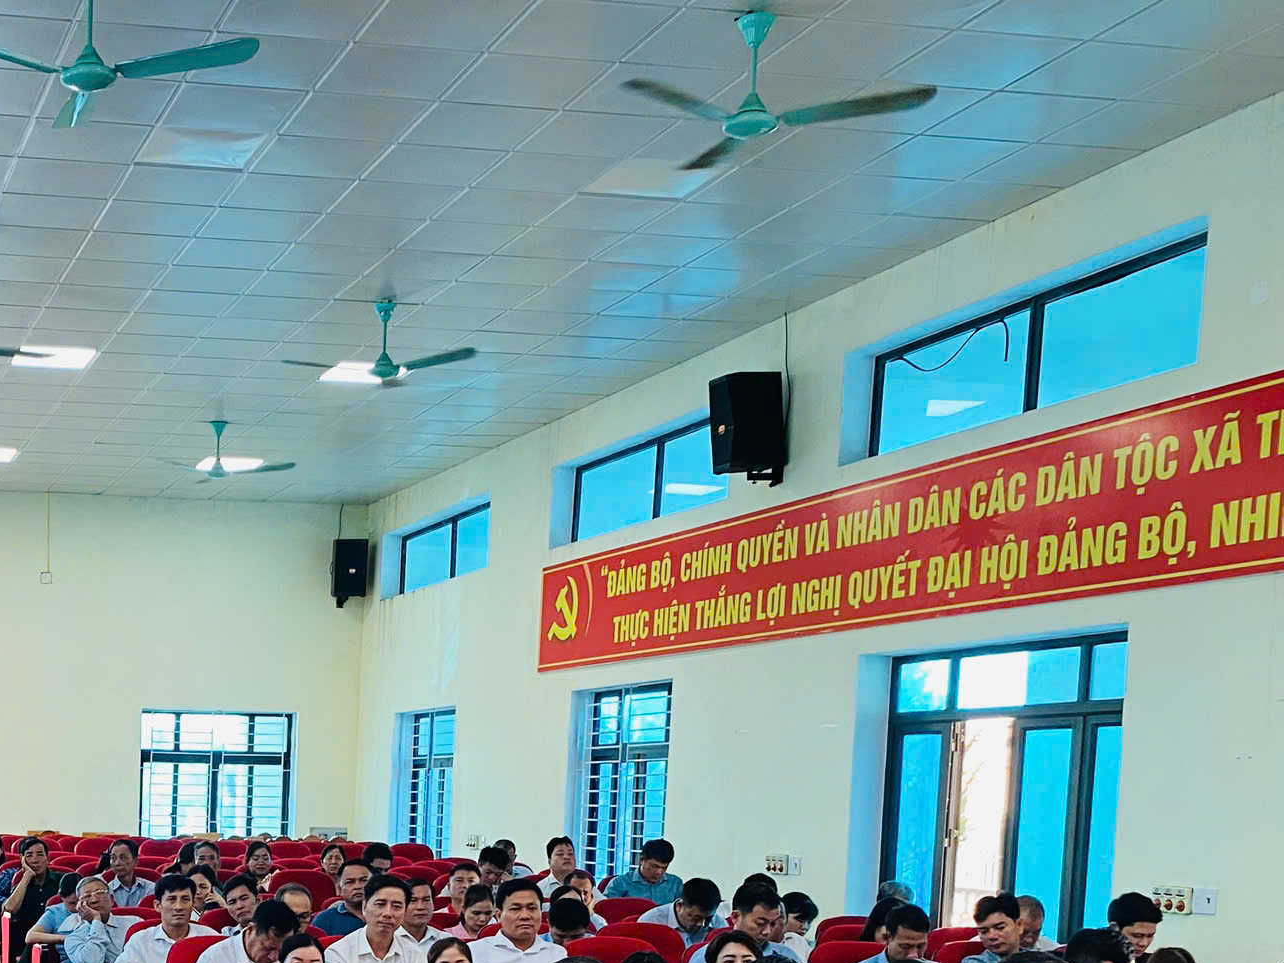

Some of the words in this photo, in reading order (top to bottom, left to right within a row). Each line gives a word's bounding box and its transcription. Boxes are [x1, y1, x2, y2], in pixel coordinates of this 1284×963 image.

[613, 611, 650, 647] THỰC
[653, 600, 691, 640] HIỆN
[695, 584, 752, 629] THẮNG
[756, 582, 786, 626] LỢI
[792, 575, 842, 616] NGHỊ
[848, 550, 922, 609] QUYẾT
[927, 550, 972, 598] ĐẠI
[979, 534, 1029, 590] HỘI
[1037, 517, 1127, 576] ĐẢNG
[1138, 501, 1196, 566] BỘ,
[1210, 491, 1284, 549] NHI
[650, 552, 676, 593] BỘ,
[680, 542, 733, 582] CHÍNH
[737, 520, 799, 573] QUYỀN
[805, 513, 830, 556] VÀ
[836, 500, 900, 549] NHÂN
[907, 485, 962, 535] DÂN
[969, 469, 1027, 520] CÁC
[1036, 452, 1103, 507] DÂN
[1113, 433, 1180, 495] TỘC
[1189, 410, 1242, 474] XÃ
[1256, 408, 1284, 459] T
